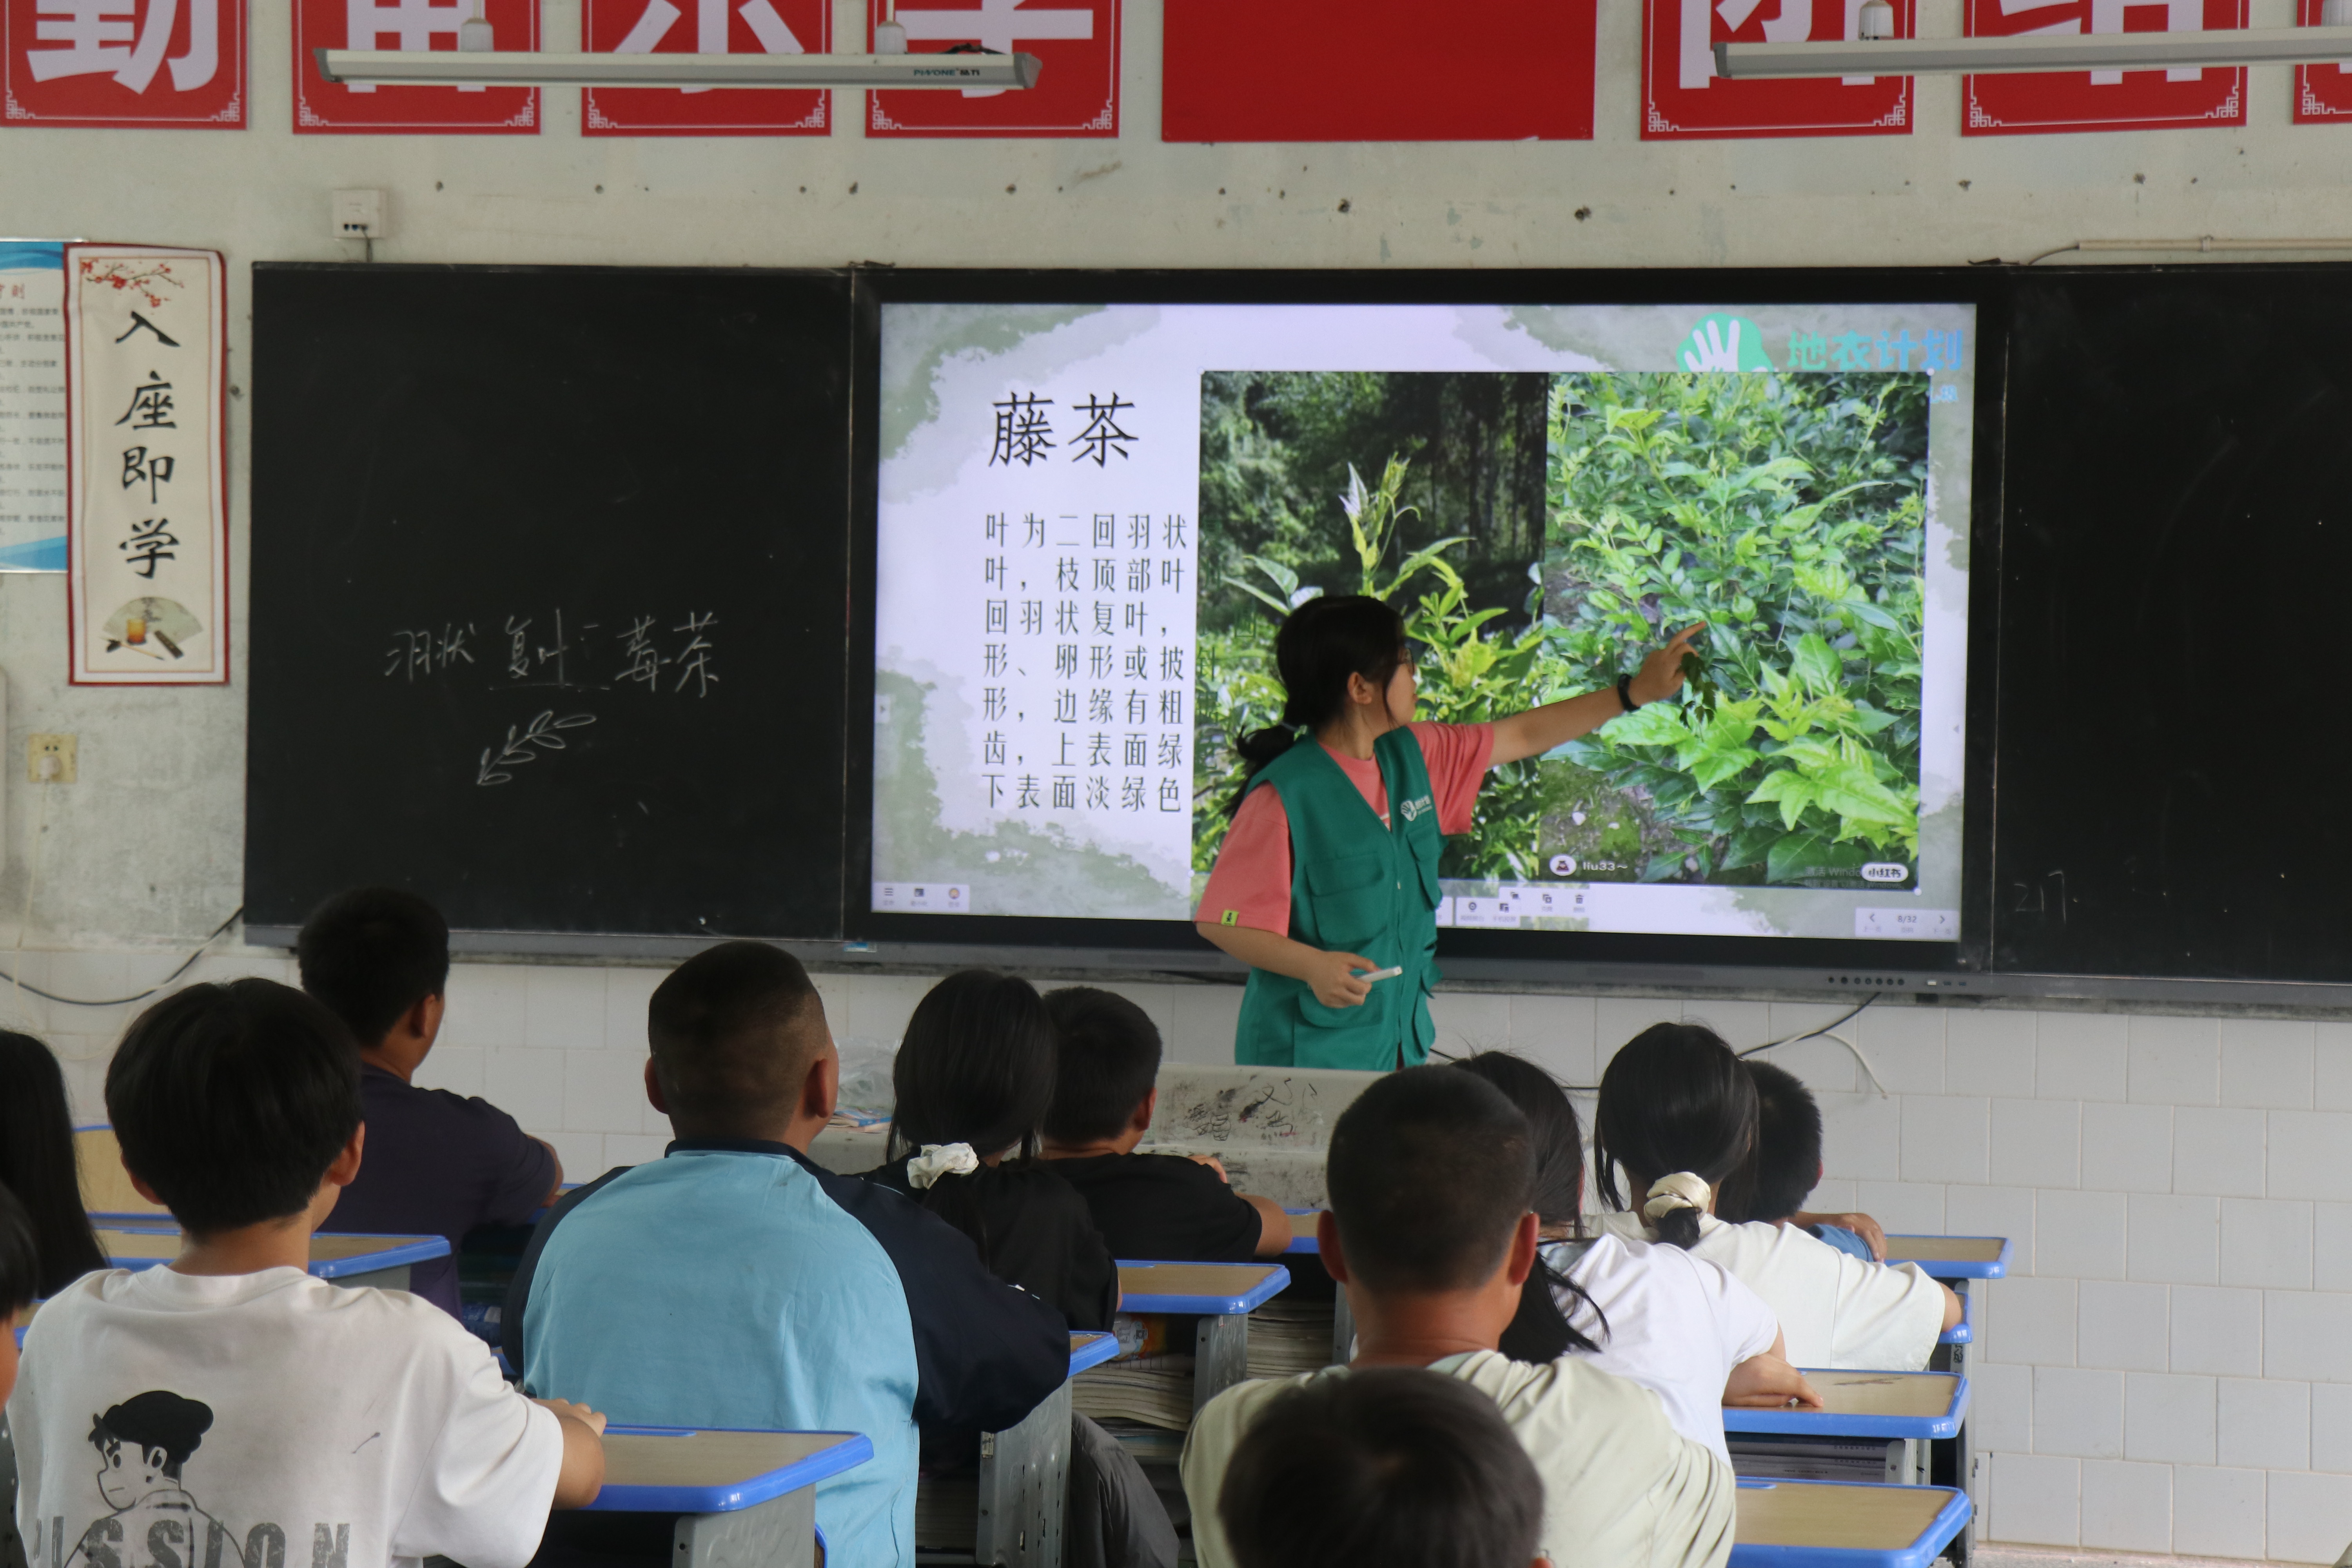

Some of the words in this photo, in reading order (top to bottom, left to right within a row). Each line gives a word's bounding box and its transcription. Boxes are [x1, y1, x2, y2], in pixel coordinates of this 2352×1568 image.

[1787, 329, 1963, 371] 地衣计划
[114, 311, 181, 579] 入座即学
[988, 391, 1139, 469] 藤茶
[982, 774, 1181, 813] 下表面淡绿色
